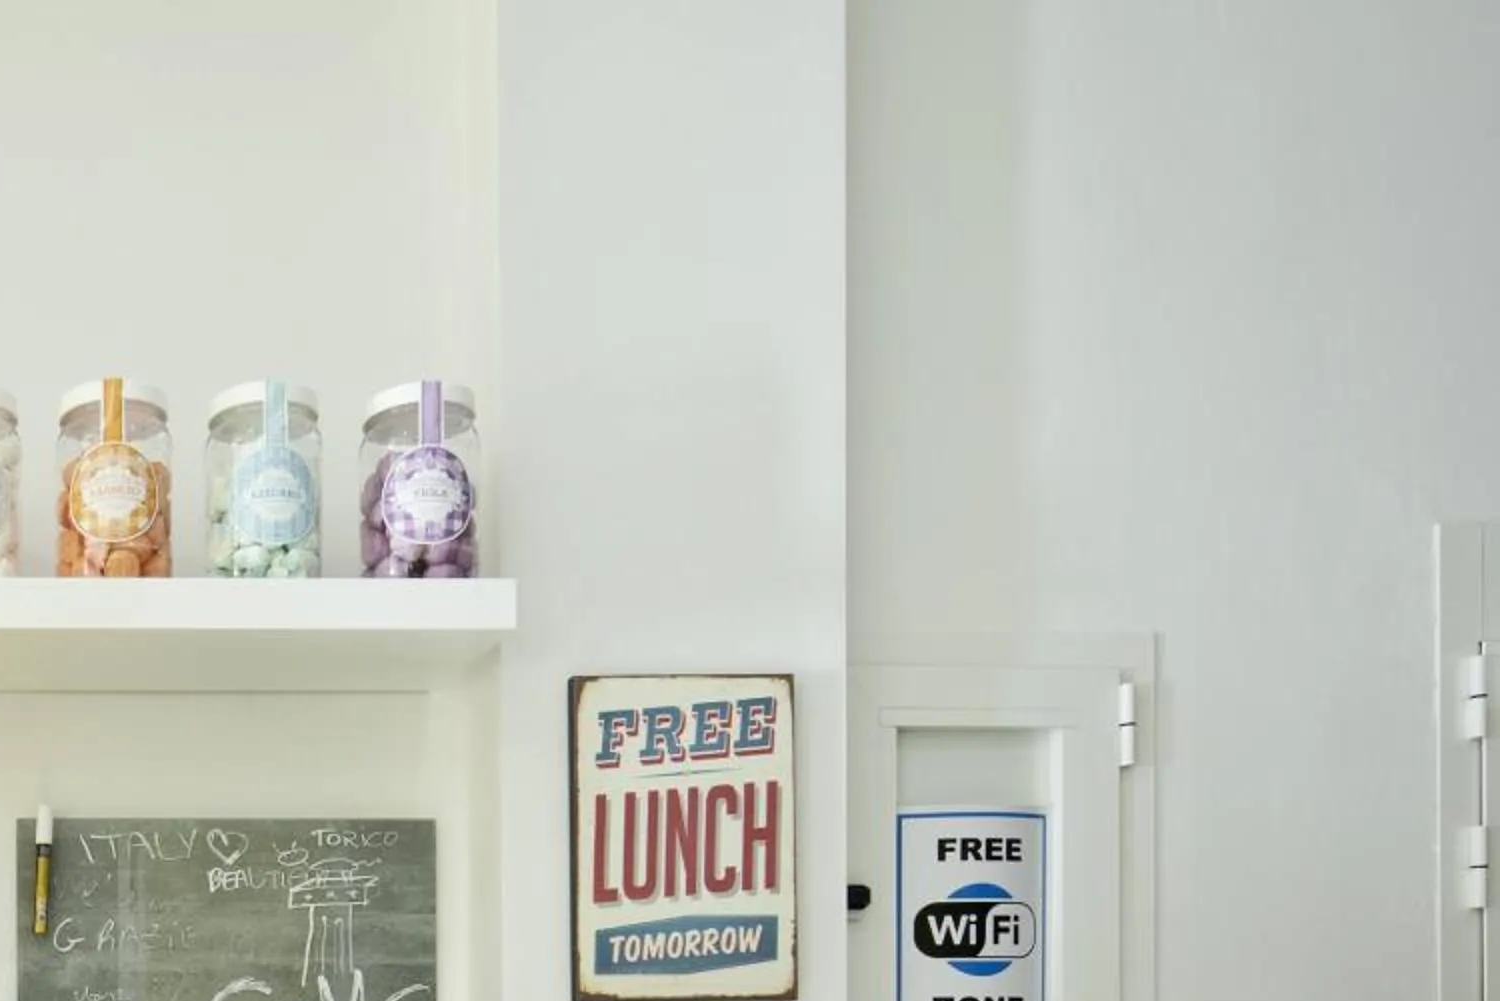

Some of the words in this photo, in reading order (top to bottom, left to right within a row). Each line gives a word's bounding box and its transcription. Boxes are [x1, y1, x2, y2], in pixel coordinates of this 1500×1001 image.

[595, 696, 778, 768] FREE
[79, 829, 197, 863] ITALY
[592, 780, 781, 906] LUNCH
[937, 838, 1022, 861] FREE
[609, 924, 763, 964] TOMORROW
